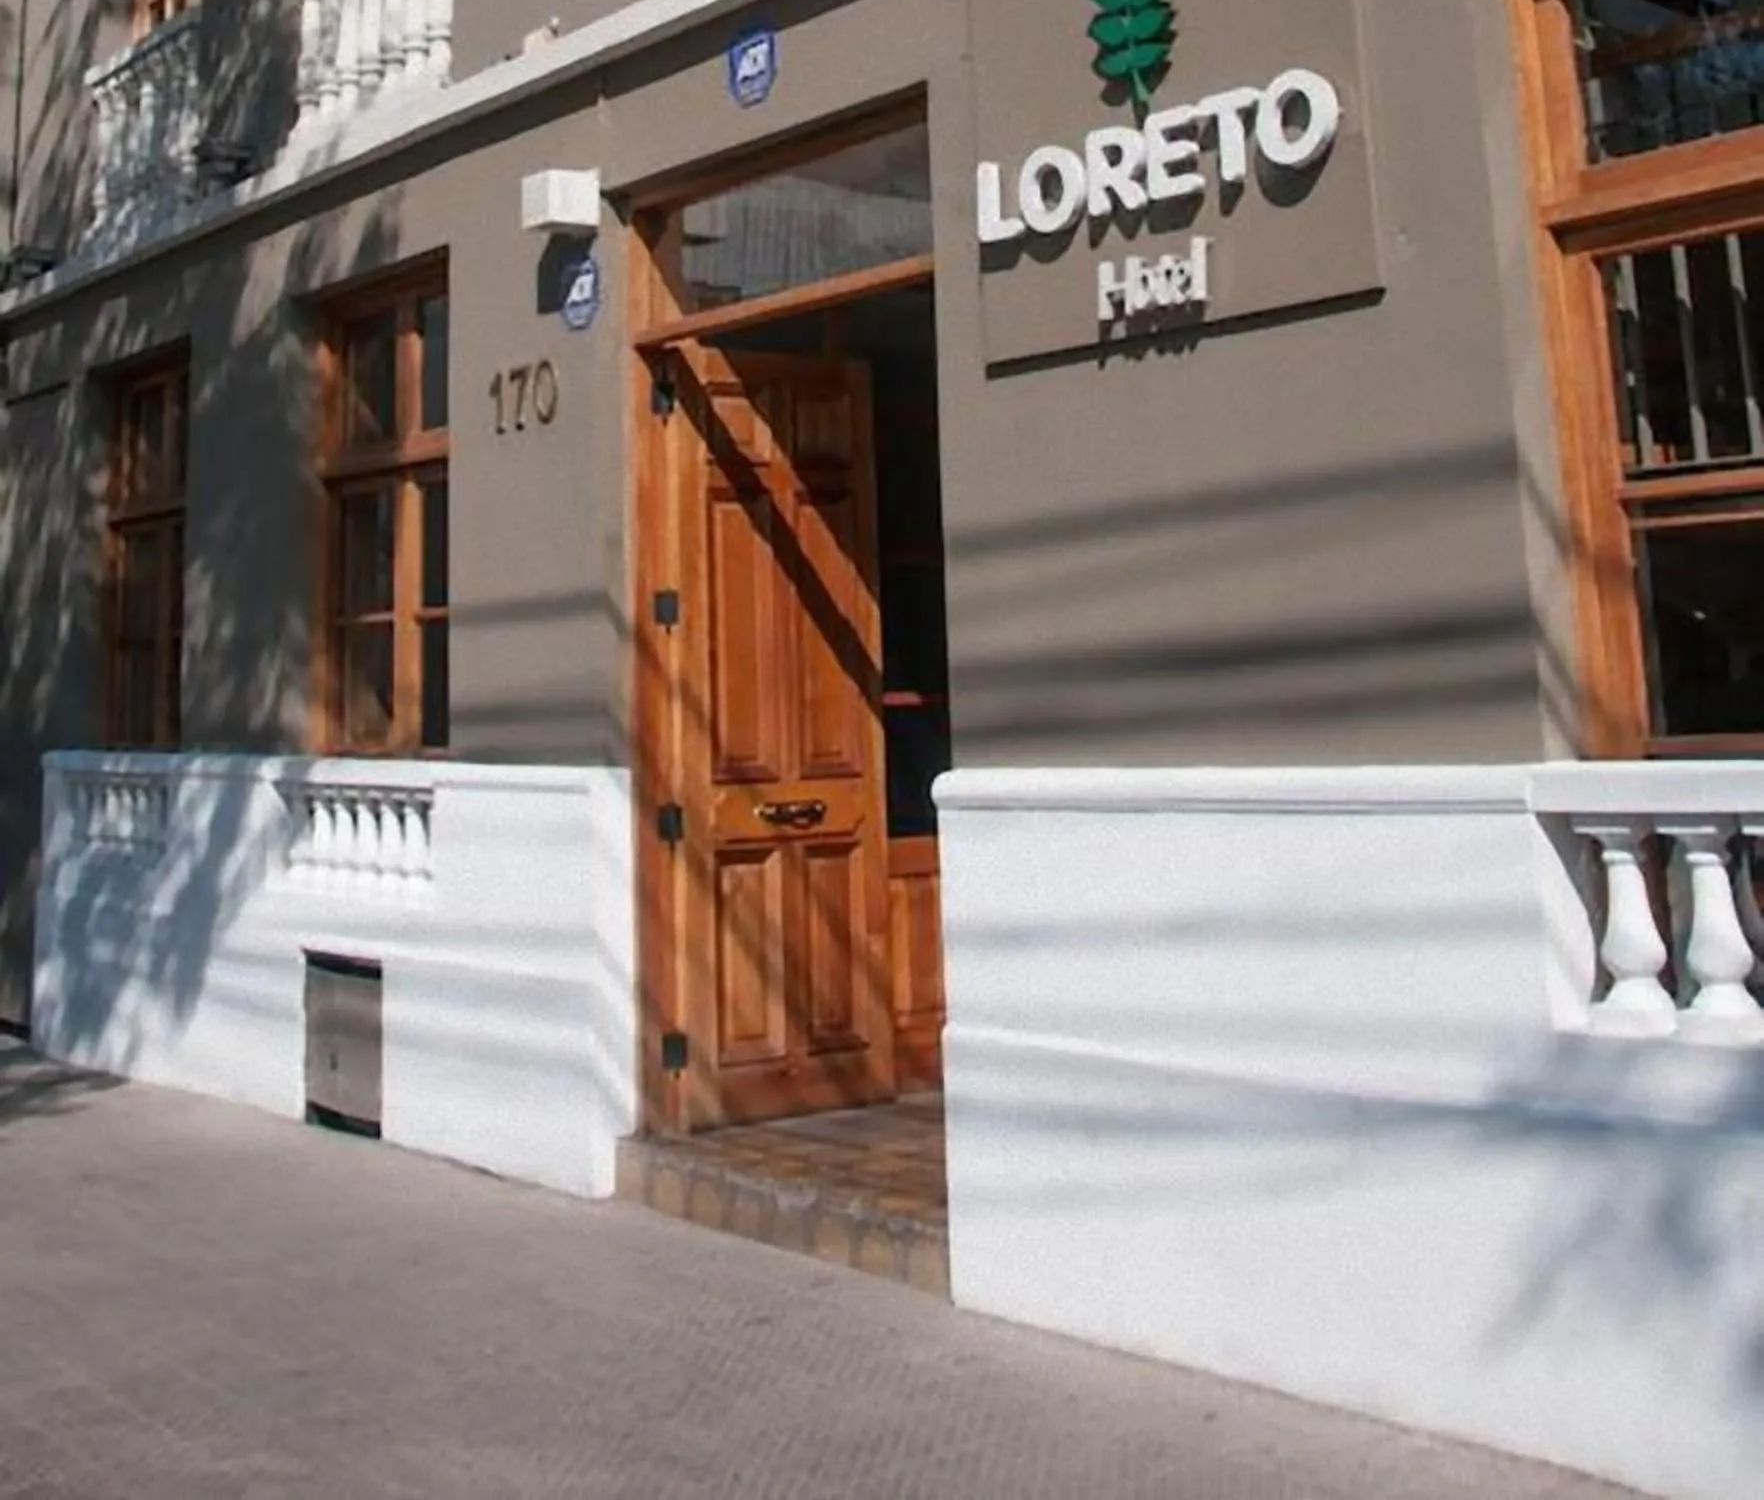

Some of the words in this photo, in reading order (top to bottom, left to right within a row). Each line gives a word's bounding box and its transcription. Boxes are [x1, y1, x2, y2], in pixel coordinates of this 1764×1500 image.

[977, 68, 1340, 242] LORETO
[1098, 236, 1207, 320] Hotel
[489, 360, 558, 434] 170
